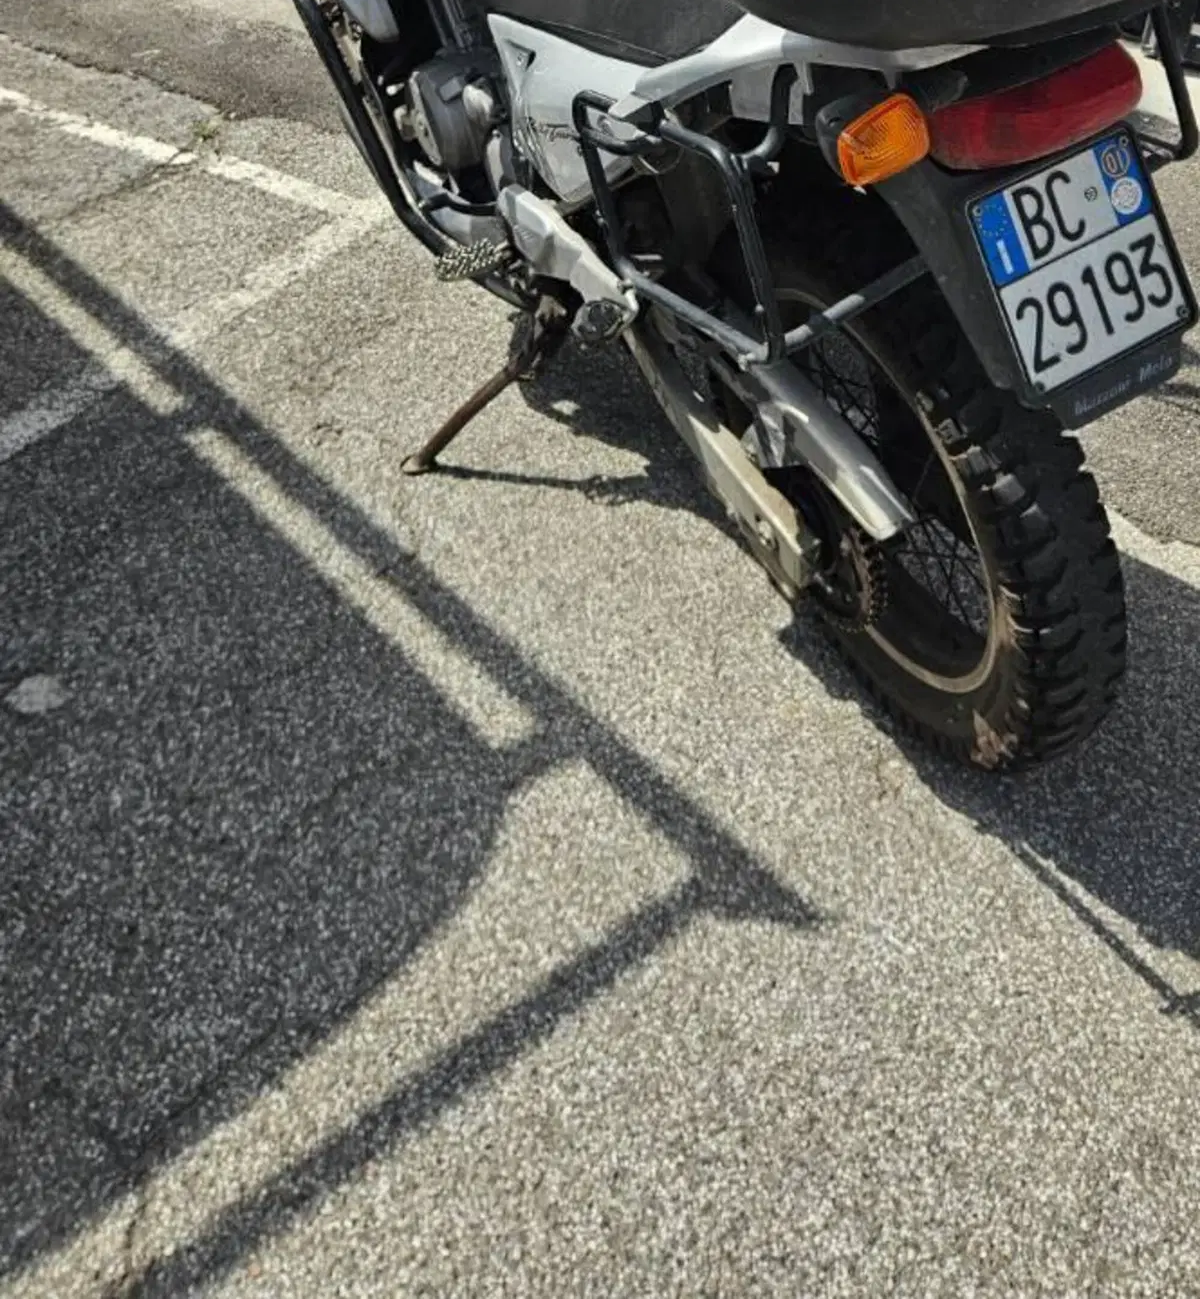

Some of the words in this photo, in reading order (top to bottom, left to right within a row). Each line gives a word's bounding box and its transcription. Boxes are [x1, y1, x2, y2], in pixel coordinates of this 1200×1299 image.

[996, 239, 1014, 275] I
[1011, 170, 1086, 260] BC
[1015, 234, 1174, 374] 29193
